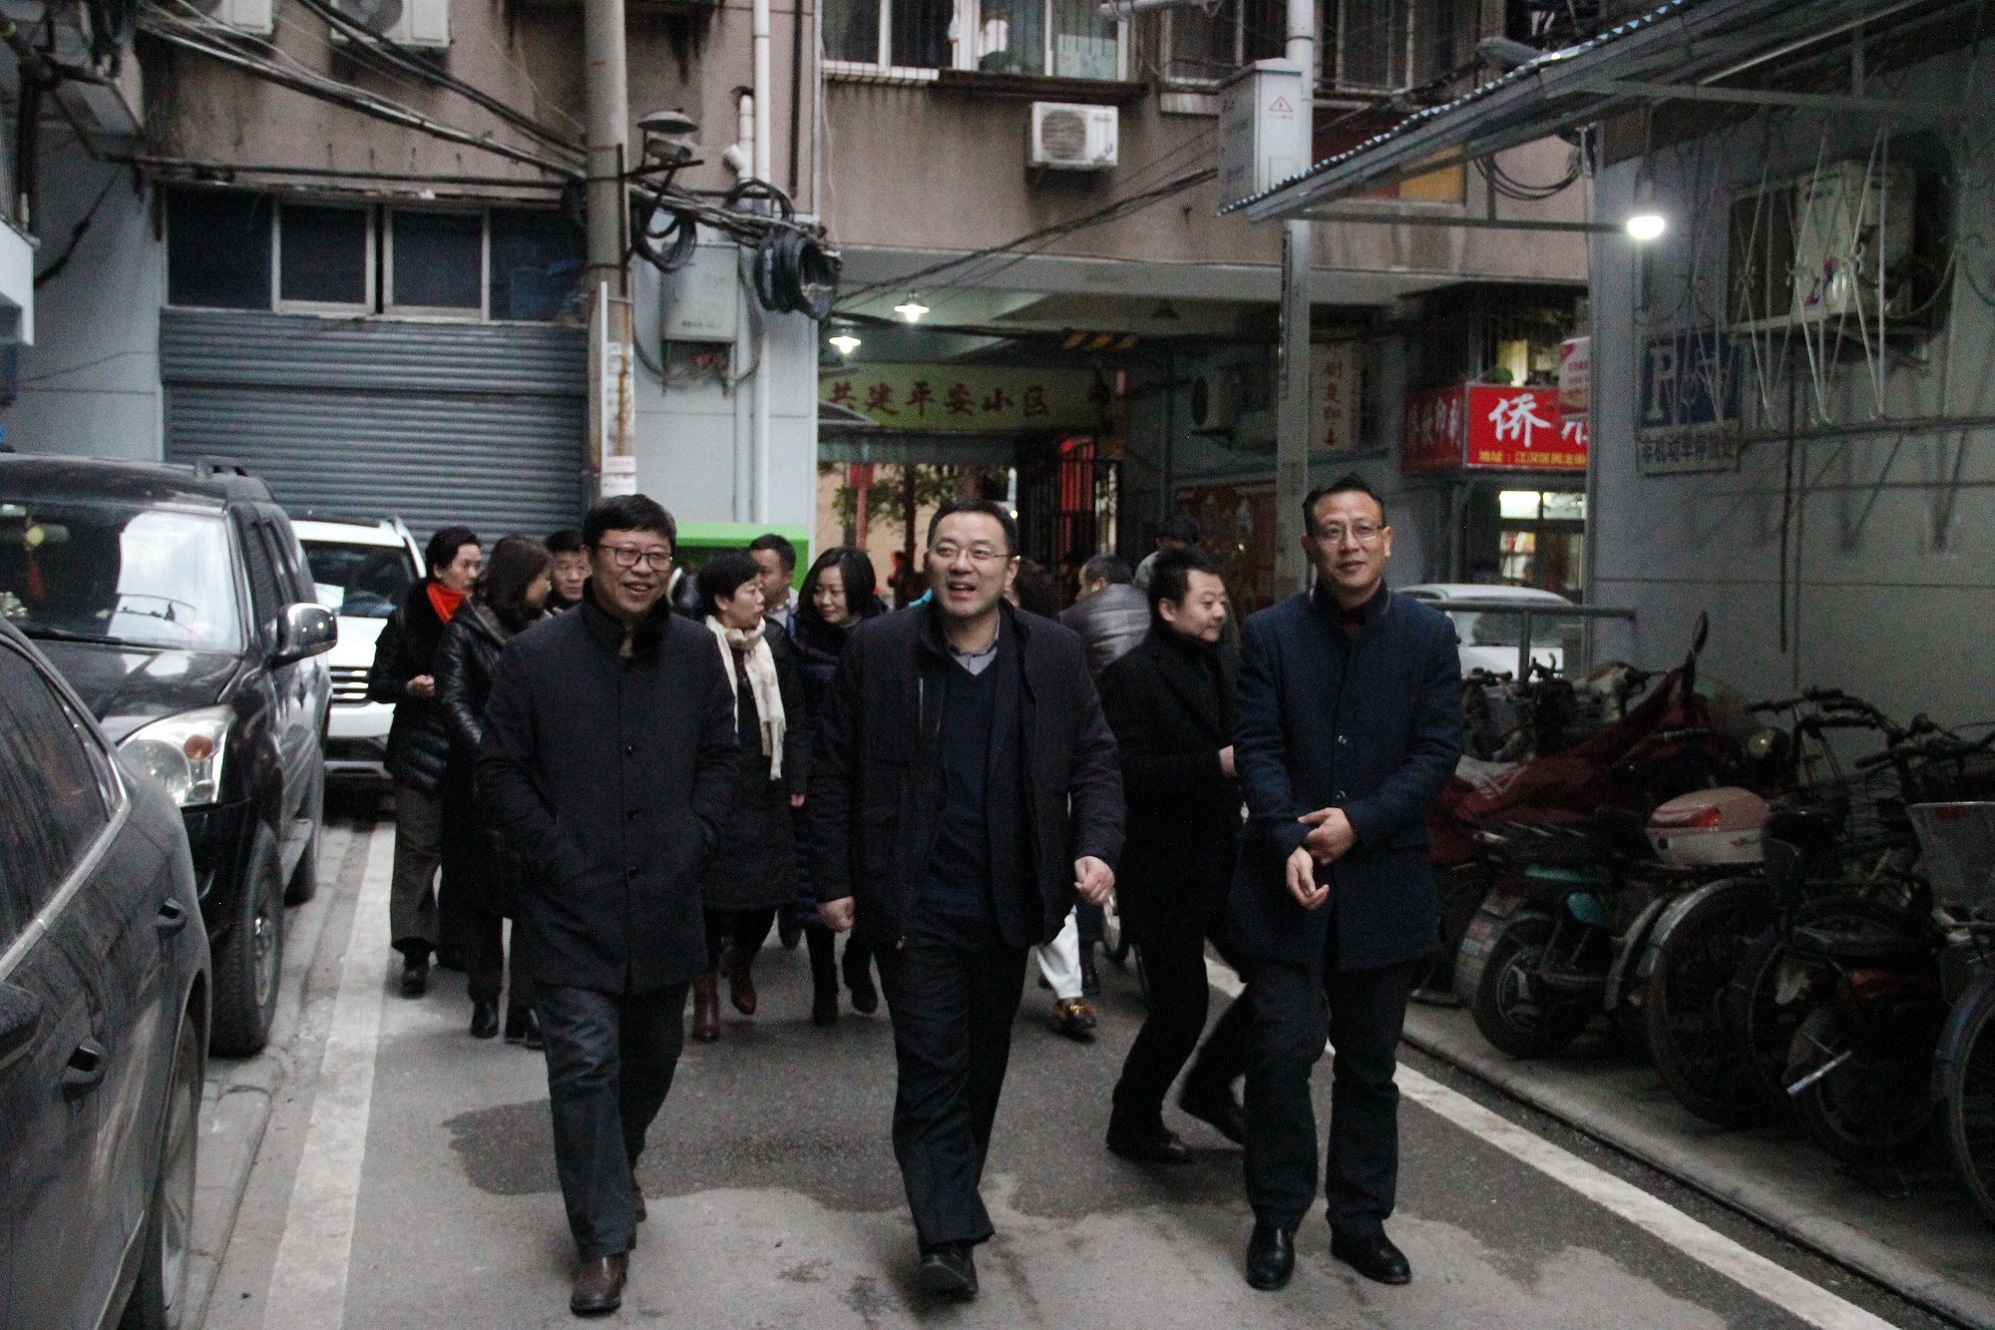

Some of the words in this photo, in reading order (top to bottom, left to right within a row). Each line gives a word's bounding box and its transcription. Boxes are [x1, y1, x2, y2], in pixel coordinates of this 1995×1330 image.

[828, 380, 1051, 417] 共建平安小区
